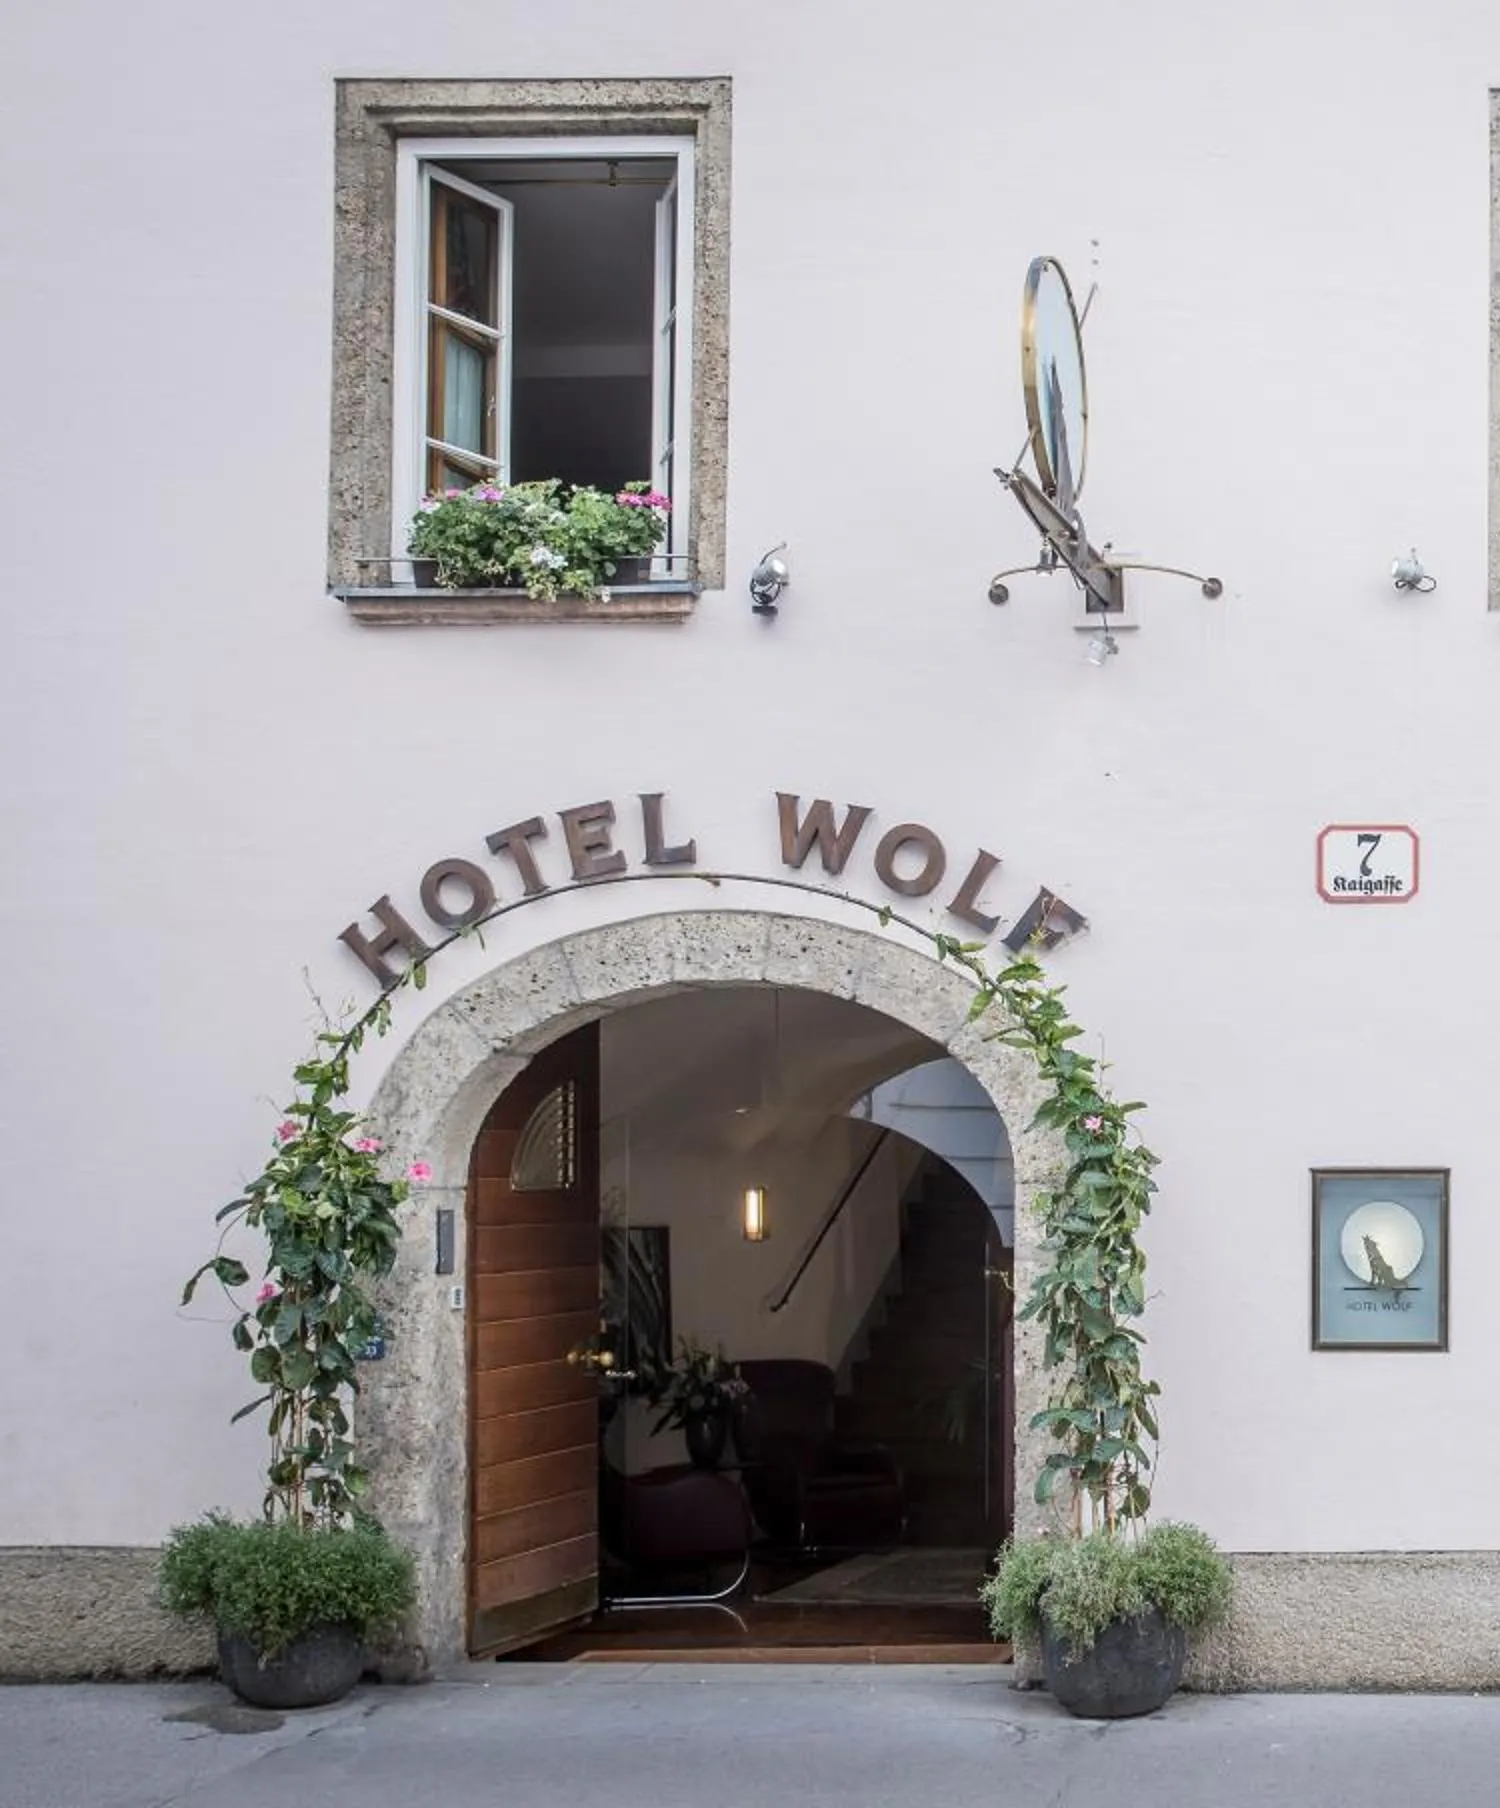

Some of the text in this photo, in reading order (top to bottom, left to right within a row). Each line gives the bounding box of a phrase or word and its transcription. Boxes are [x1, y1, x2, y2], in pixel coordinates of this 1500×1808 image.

[336, 791, 1089, 990] HOTEL WOLF
[1357, 833, 1381, 876] 7
